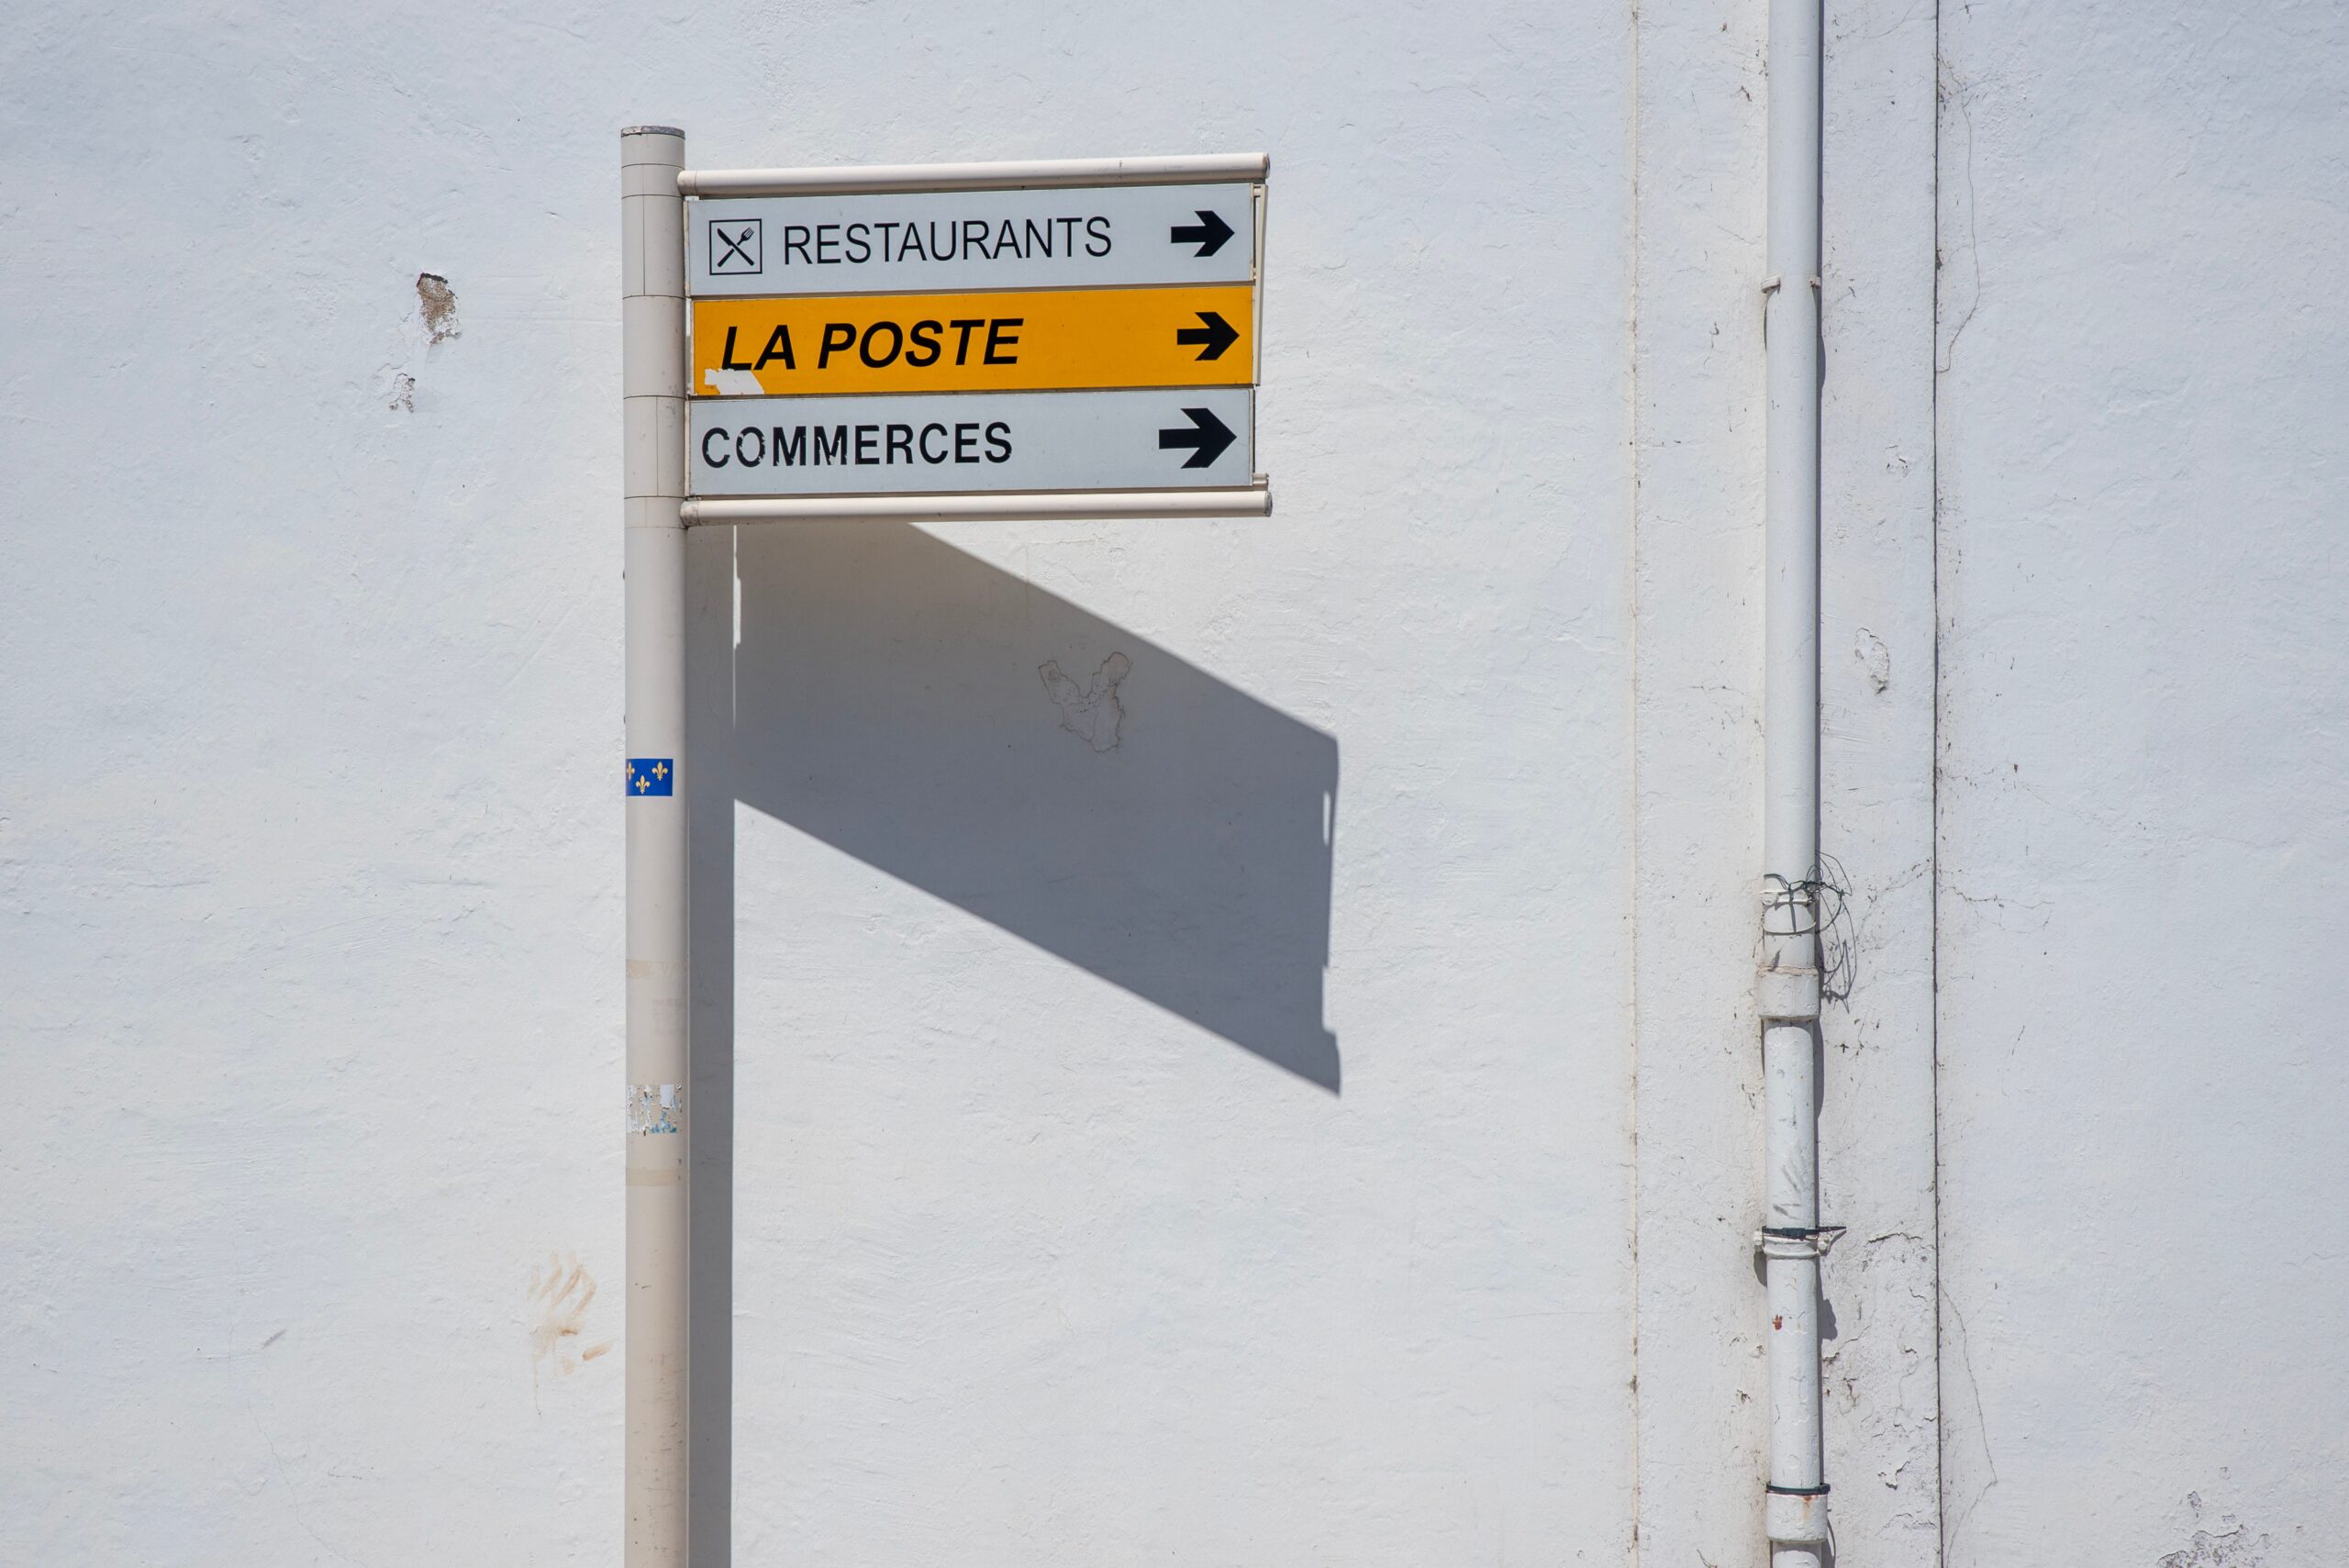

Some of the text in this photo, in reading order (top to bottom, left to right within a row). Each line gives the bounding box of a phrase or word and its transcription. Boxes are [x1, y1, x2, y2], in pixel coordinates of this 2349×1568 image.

[784, 216, 1112, 265] RESTAURANTS
[721, 317, 1024, 372] LA POSTE
[701, 421, 1012, 469] COMMERCES
